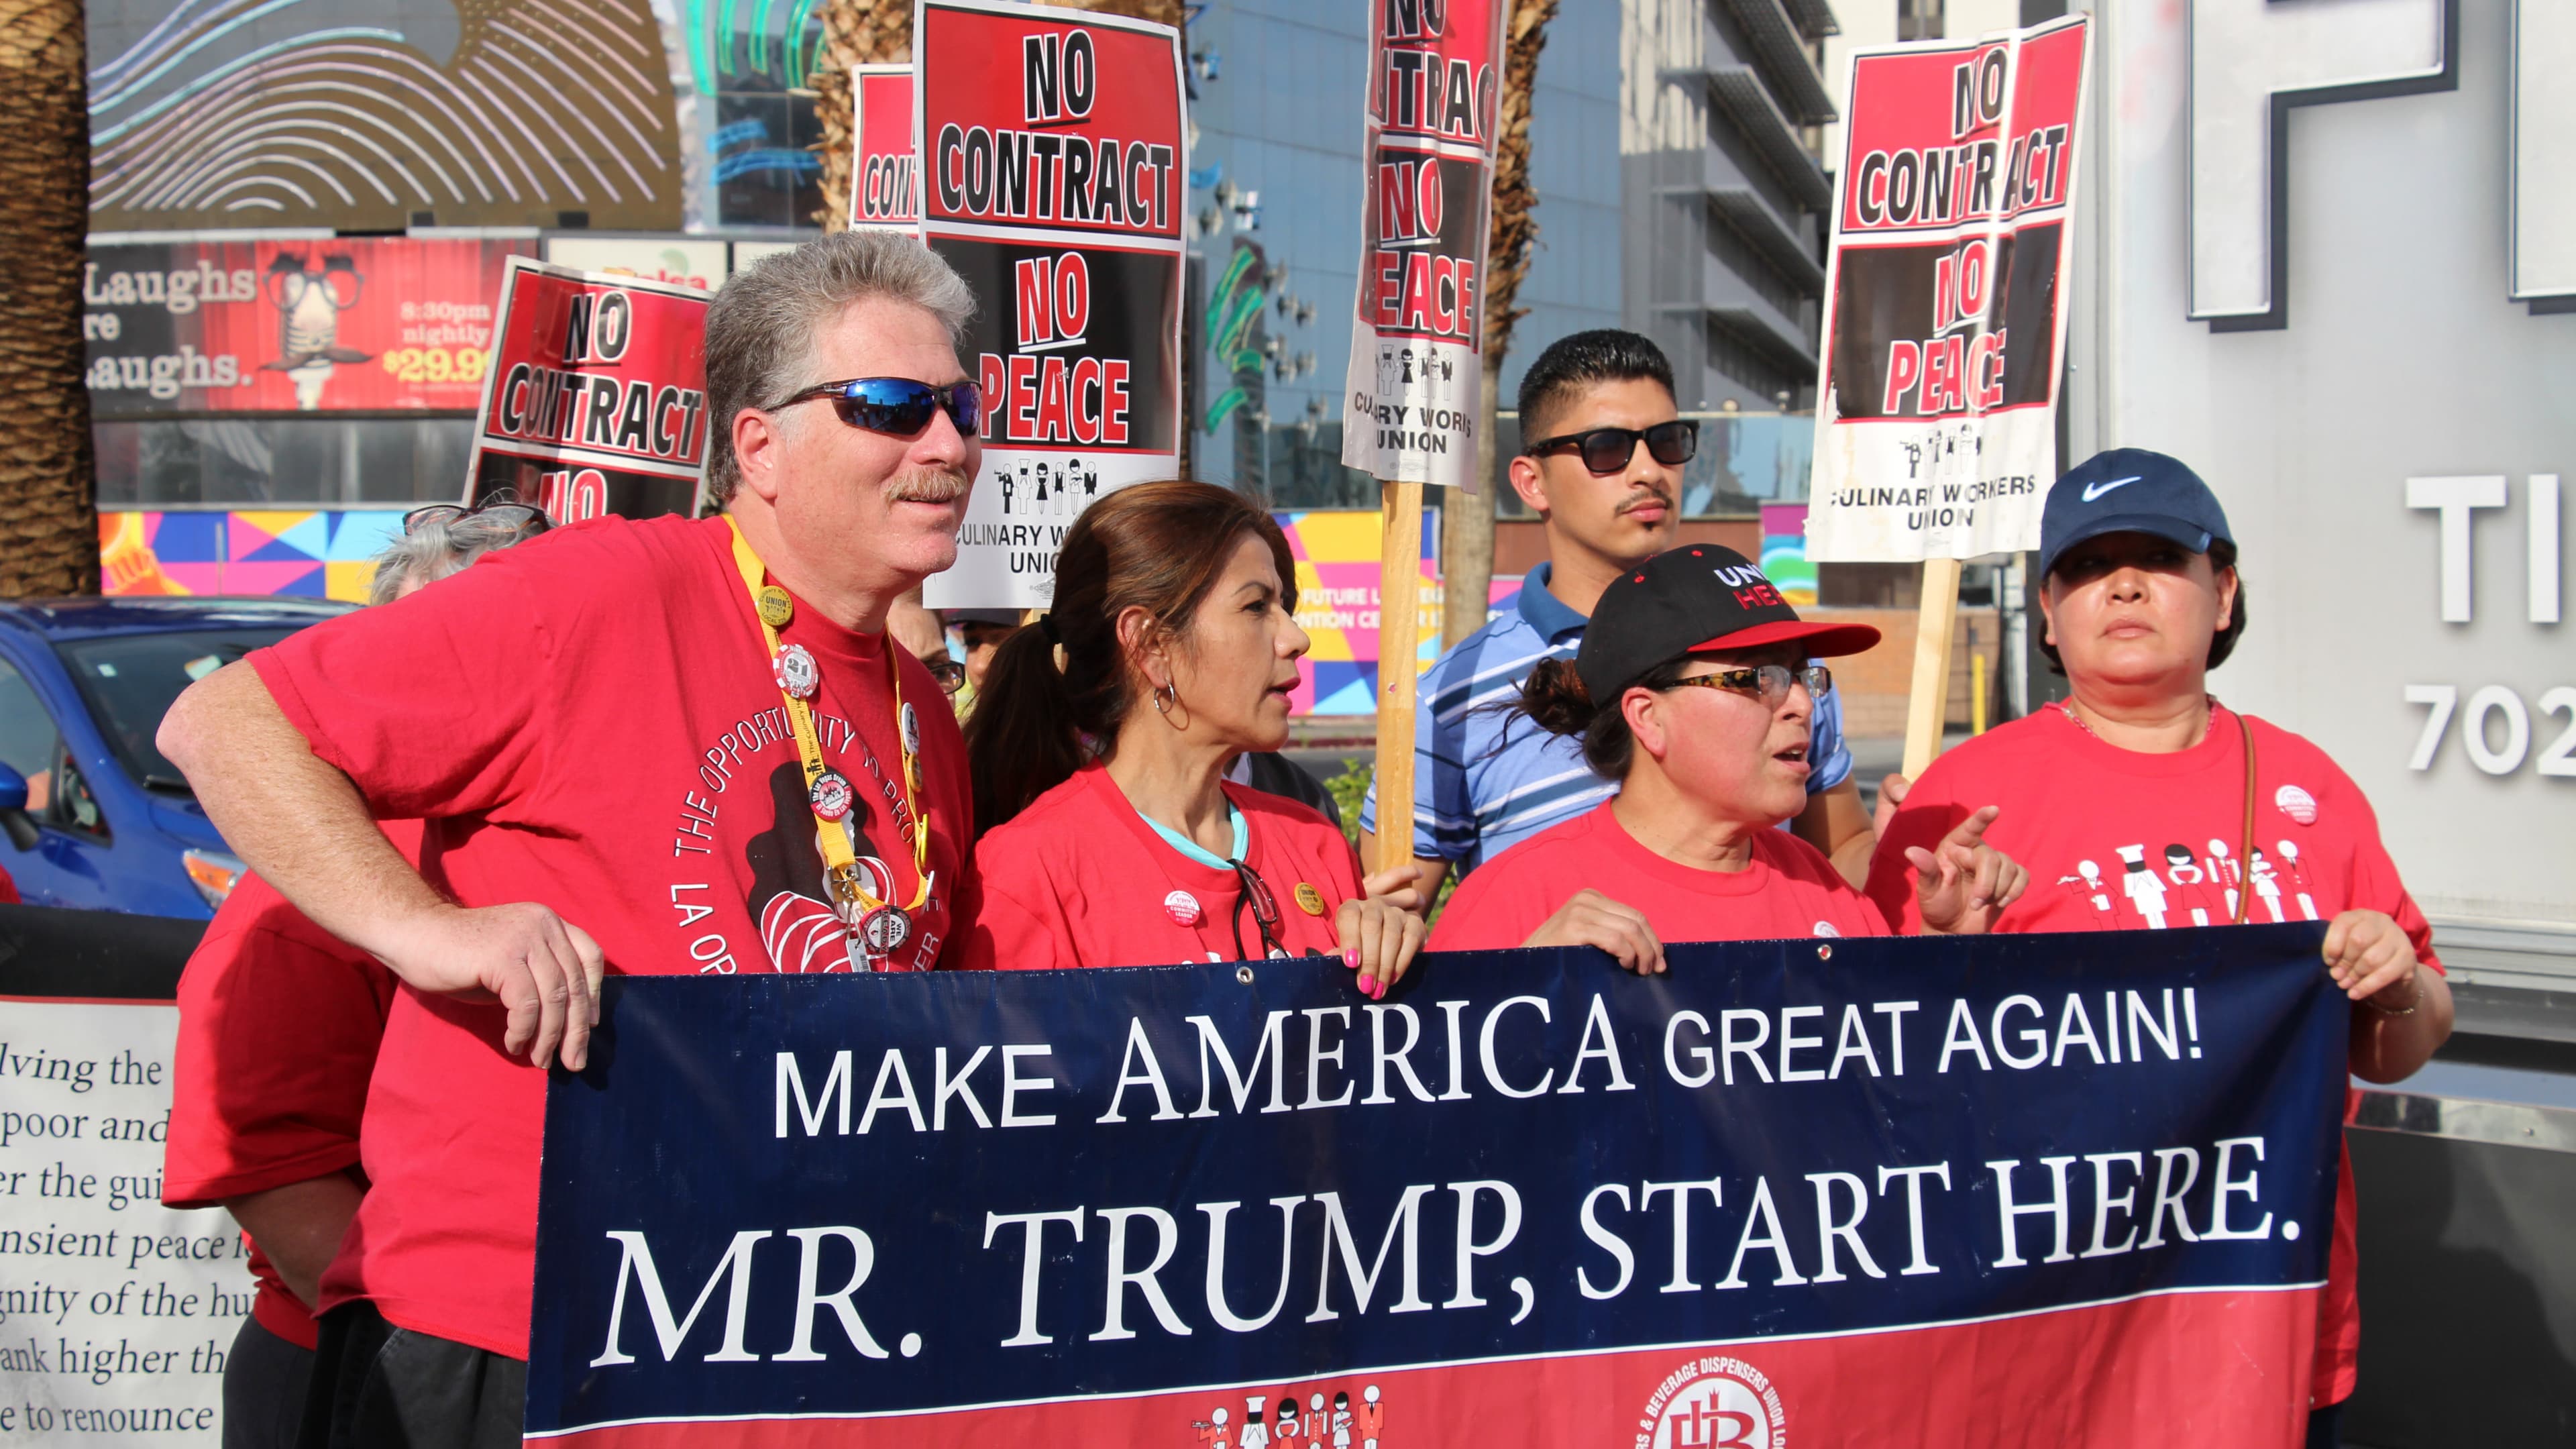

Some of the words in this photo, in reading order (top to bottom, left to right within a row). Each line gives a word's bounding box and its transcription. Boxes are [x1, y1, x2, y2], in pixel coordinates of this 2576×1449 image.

[1023, 29, 1095, 123] NO
[1952, 46, 2010, 140] NO
[938, 123, 1173, 229] CONTRACT
[1857, 123, 2068, 226] CONTRACT
[1379, 157, 1443, 241] NO
[83, 260, 256, 313] Laughs
[1015, 252, 1089, 346] NO
[1376, 250, 1475, 335] EACE
[1935, 239, 1990, 332] NO
[83, 313, 121, 340] re
[402, 323, 490, 348] nightly
[564, 290, 631, 363] NO
[1882, 327, 2007, 415] PEACE
[500, 363, 704, 459] CONTRACT
[979, 353, 1130, 444] PEACE
[1377, 429, 1446, 454] UNION
[539, 468, 608, 525] NO
[1943, 474, 2036, 502] WORKERS
[1908, 507, 1975, 531] UNION
[766, 596, 787, 608] UNION
[1303, 588, 1367, 606] FUTURE
[761, 612, 778, 625] LOCAL
[788, 658, 808, 677] 21
[813, 782, 822, 792] Las
[818, 774, 833, 784] Vegas
[833, 773, 847, 787] Dream
[674, 790, 718, 857] THE
[671, 883, 714, 928] LA
[1170, 906, 1197, 916] COMMITTEE
[1175, 911, 1193, 919] LEADER
[881, 910, 890, 951] READY
[896, 922, 903, 937] WE
[109, 1049, 162, 1085] the
[775, 1044, 1058, 1138] MAKE
[1095, 993, 1636, 1124] AMERICA
[1664, 1000, 1919, 1089] GREAT
[1938, 987, 2203, 1073] AGAIN!
[0, 1111, 89, 1148] poor
[100, 1108, 172, 1143] and
[40, 1161, 97, 1198] the
[127, 1234, 225, 1270] peace
[590, 1226, 922, 1368] MR.
[983, 1179, 1535, 1348] TRUMP,
[1576, 1161, 1952, 1300] START
[1986, 1136, 2301, 1269] HERE.
[90, 1280, 136, 1316] of
[141, 1281, 199, 1317] the
[207, 1281, 256, 1317] hu
[0, 1338, 51, 1373] ank
[59, 1338, 180, 1385] higher
[1699, 1355, 1770, 1393] DISPENSERS
[1645, 1360, 1699, 1419] BEVERAGE
[1762, 1386, 1785, 1428] UNION
[25, 1402, 54, 1432] to
[62, 1405, 214, 1433] renounce
[1640, 1419, 1655, 1432] &
